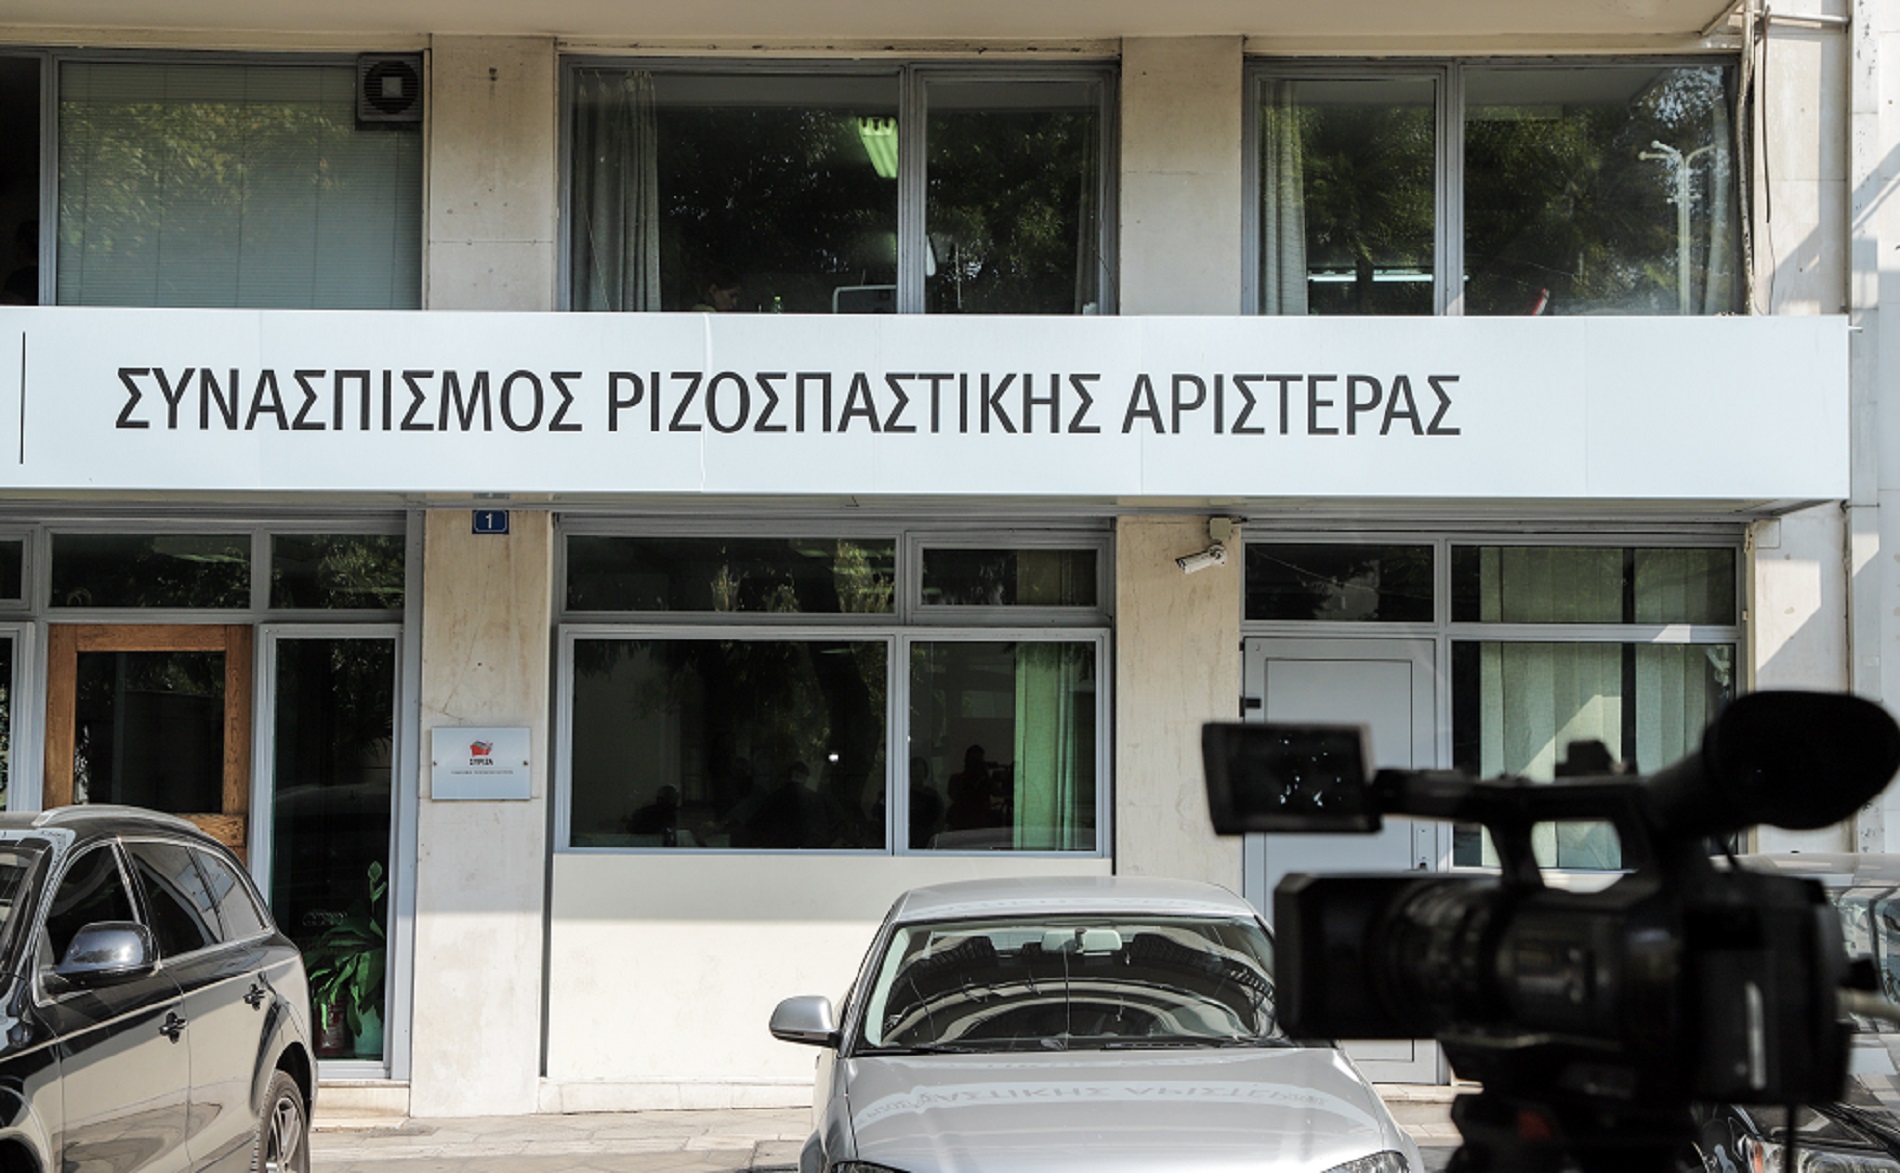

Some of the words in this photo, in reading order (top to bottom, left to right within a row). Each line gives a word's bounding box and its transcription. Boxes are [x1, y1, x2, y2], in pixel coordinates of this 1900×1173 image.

[115, 367, 583, 432] ΣΥΝΑΣΠΙΣΜΟΣ
[608, 371, 1101, 434] ΡΙΖΟΣΠΑΣΤΙΚΗΣ
[1121, 373, 1461, 436] ΑΡΙΣΤΕΡΑΣ
[485, 512, 493, 530] 1
